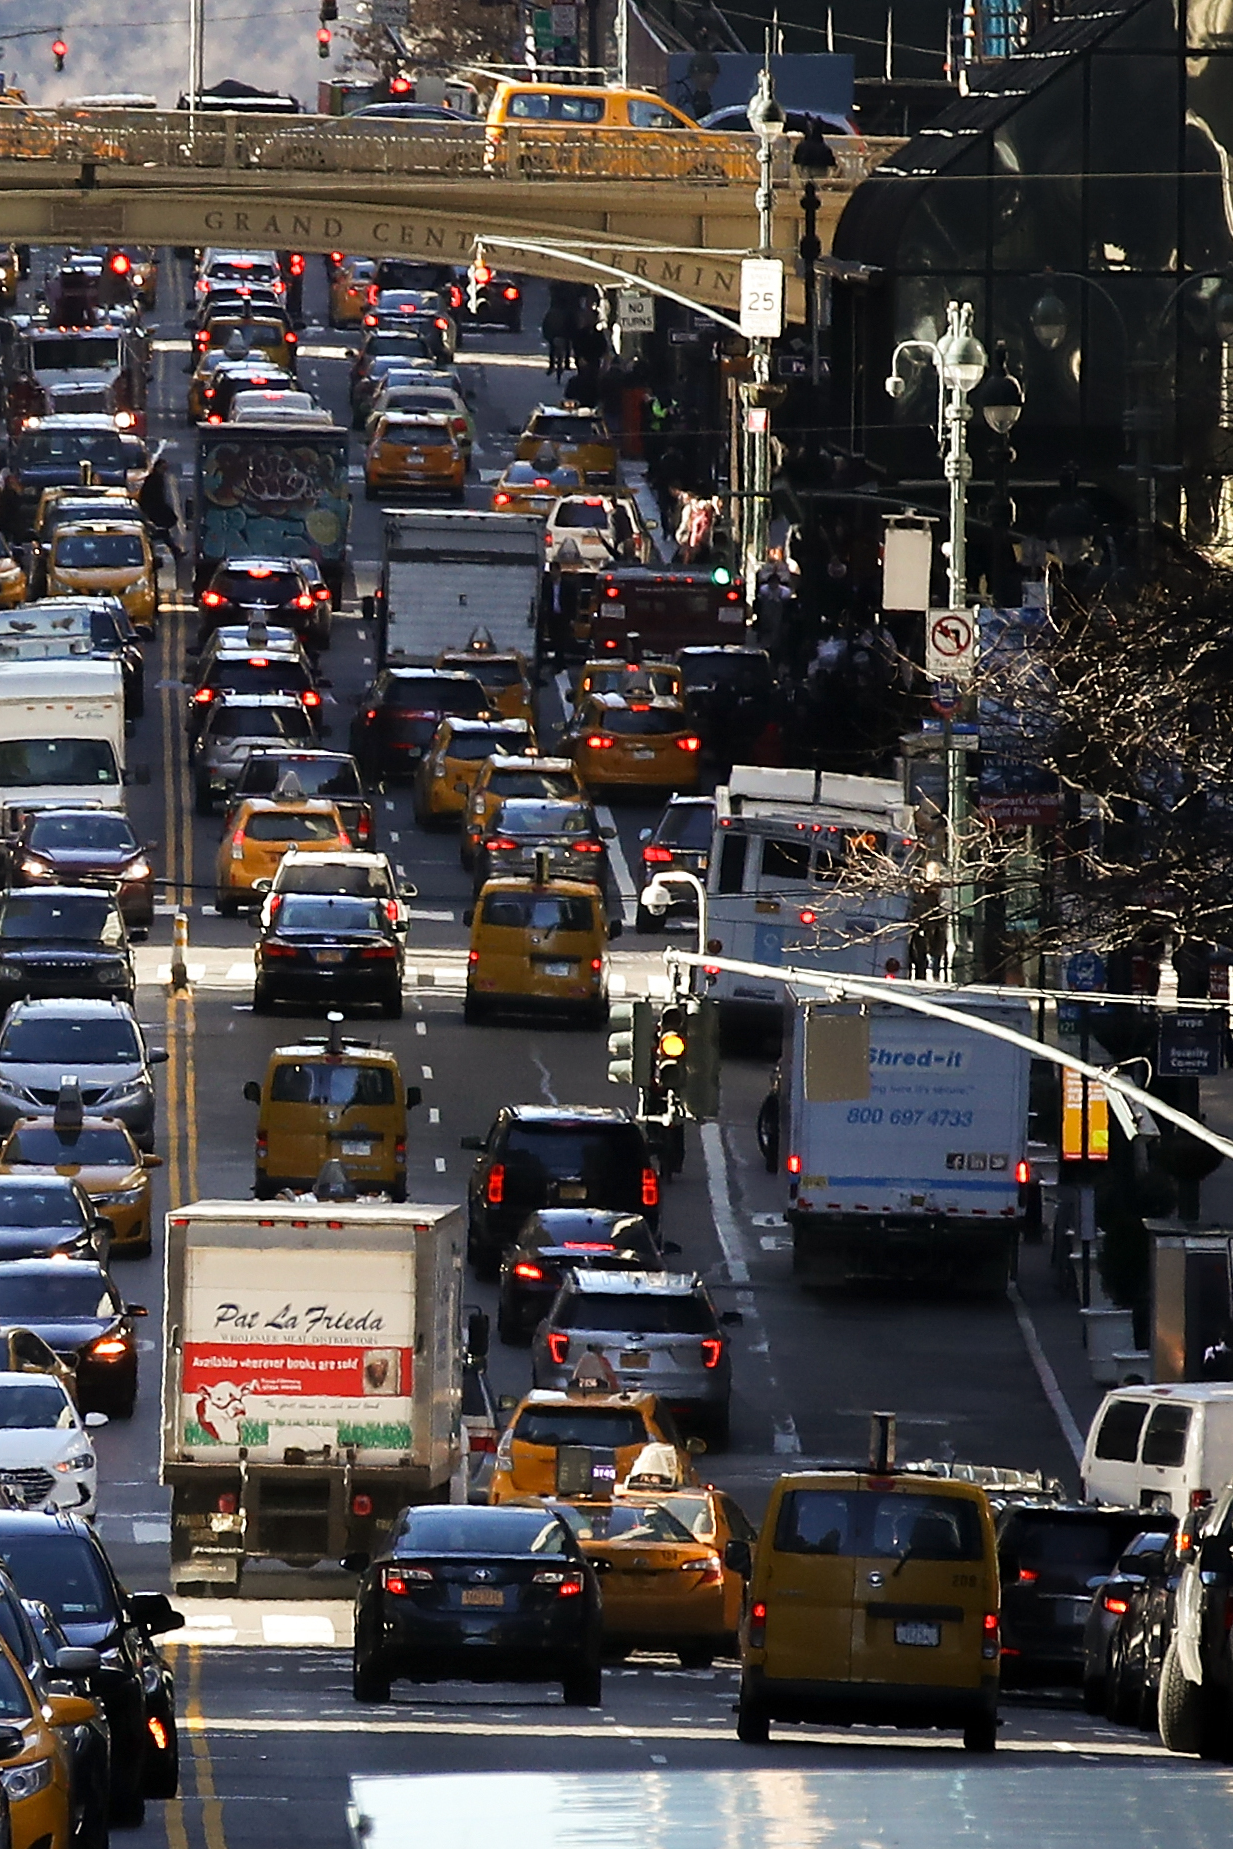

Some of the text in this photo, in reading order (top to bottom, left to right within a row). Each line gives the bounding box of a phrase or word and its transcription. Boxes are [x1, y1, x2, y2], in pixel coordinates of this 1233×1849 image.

[204, 210, 736, 292] GRAND CENT TERMIN
[628, 303, 644, 312] NO
[747, 292, 775, 311] 25
[621, 317, 652, 326] TURNS
[869, 1047, 962, 1068] Shred-it
[847, 1107, 973, 1127] 800 697 4733
[214, 1302, 386, 1333] Pat La Frieda
[283, 1334, 307, 1343] MEAT
[311, 1336, 379, 1345] DISTRIBUTORS
[192, 1356, 359, 1371] Available wherever books are sold
